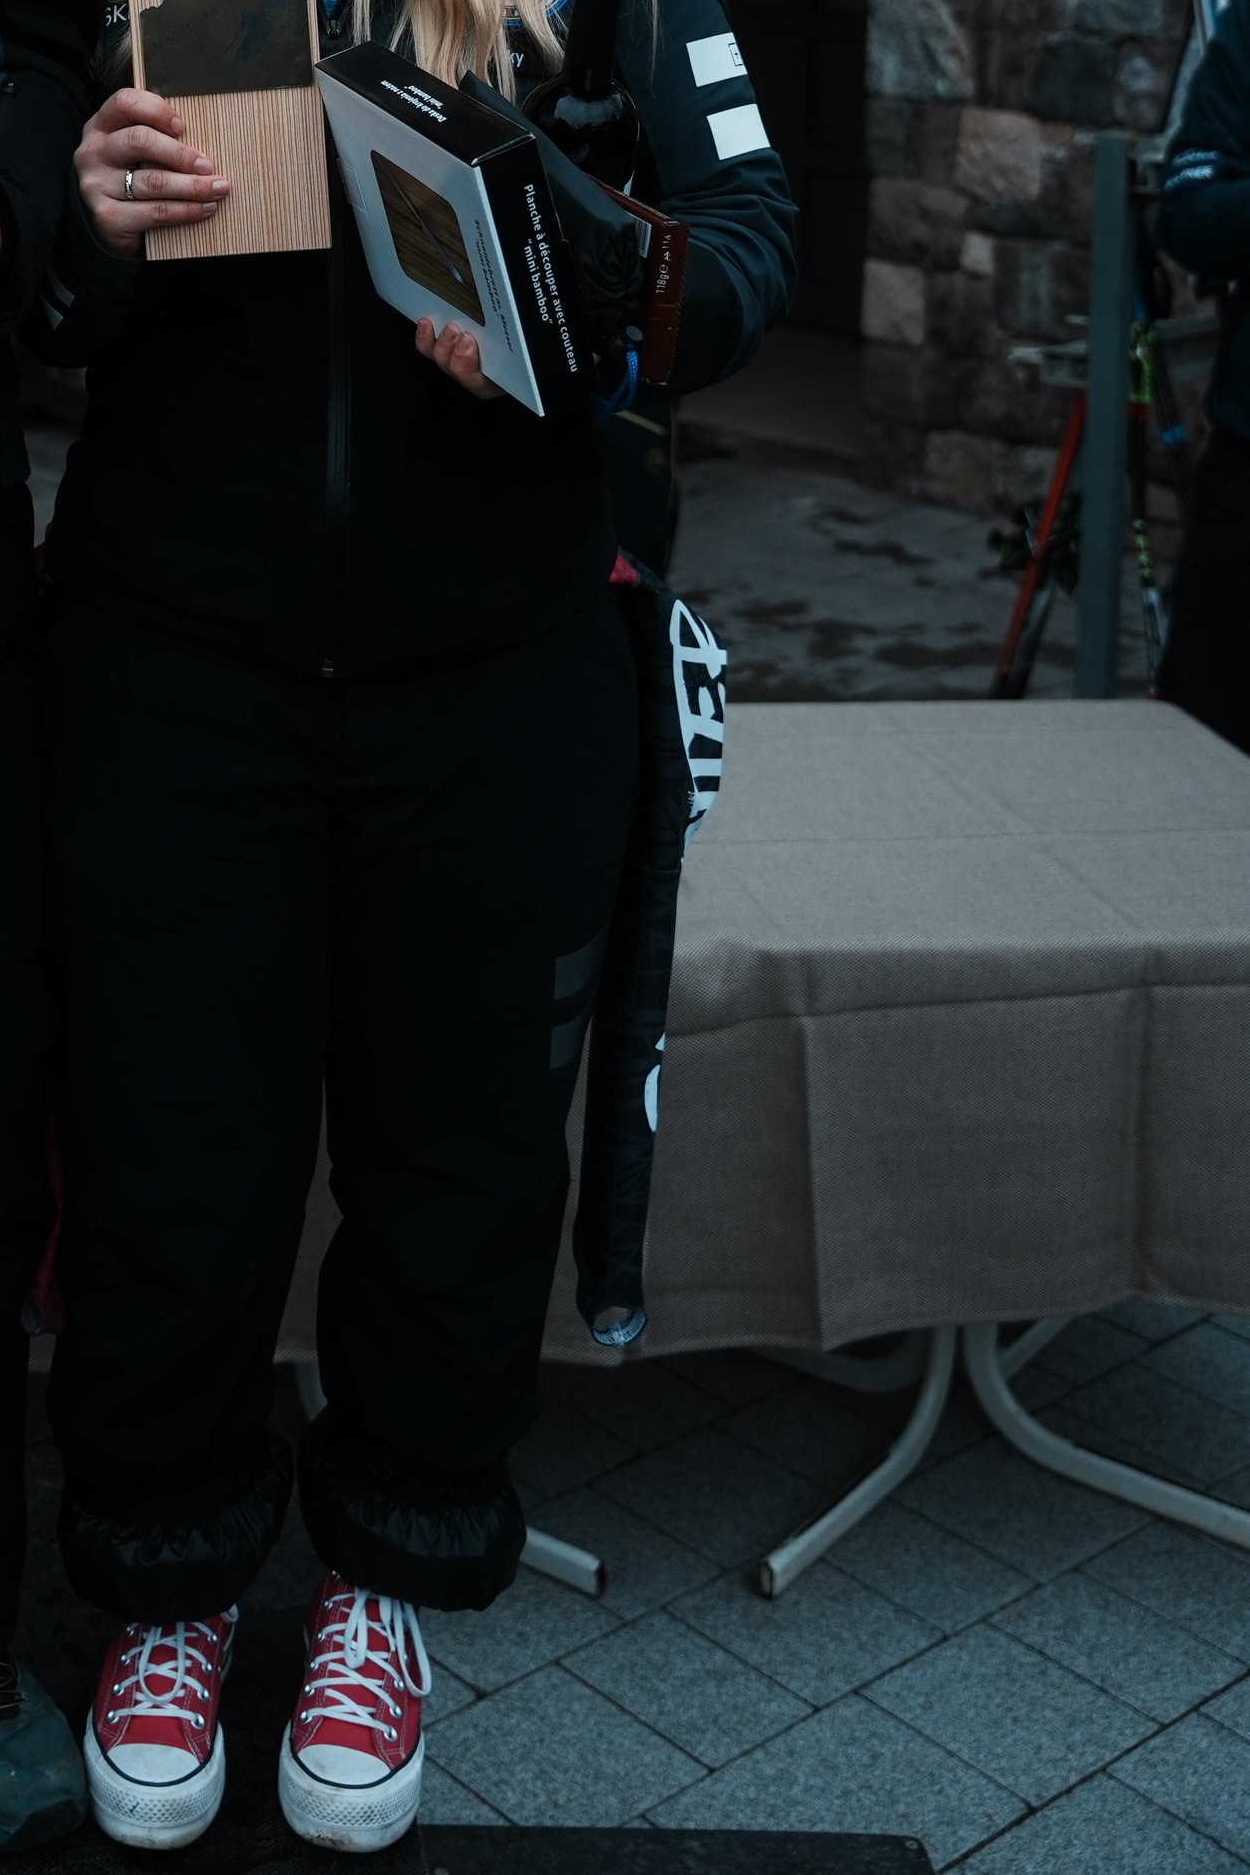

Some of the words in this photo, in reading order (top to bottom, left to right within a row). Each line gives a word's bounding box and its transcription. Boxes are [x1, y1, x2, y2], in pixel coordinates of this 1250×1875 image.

[523, 183, 542, 231] Planche
[536, 232, 546, 241] à
[538, 241, 559, 297] découper
[552, 298, 566, 325] avec
[560, 326, 578, 373] couteau
